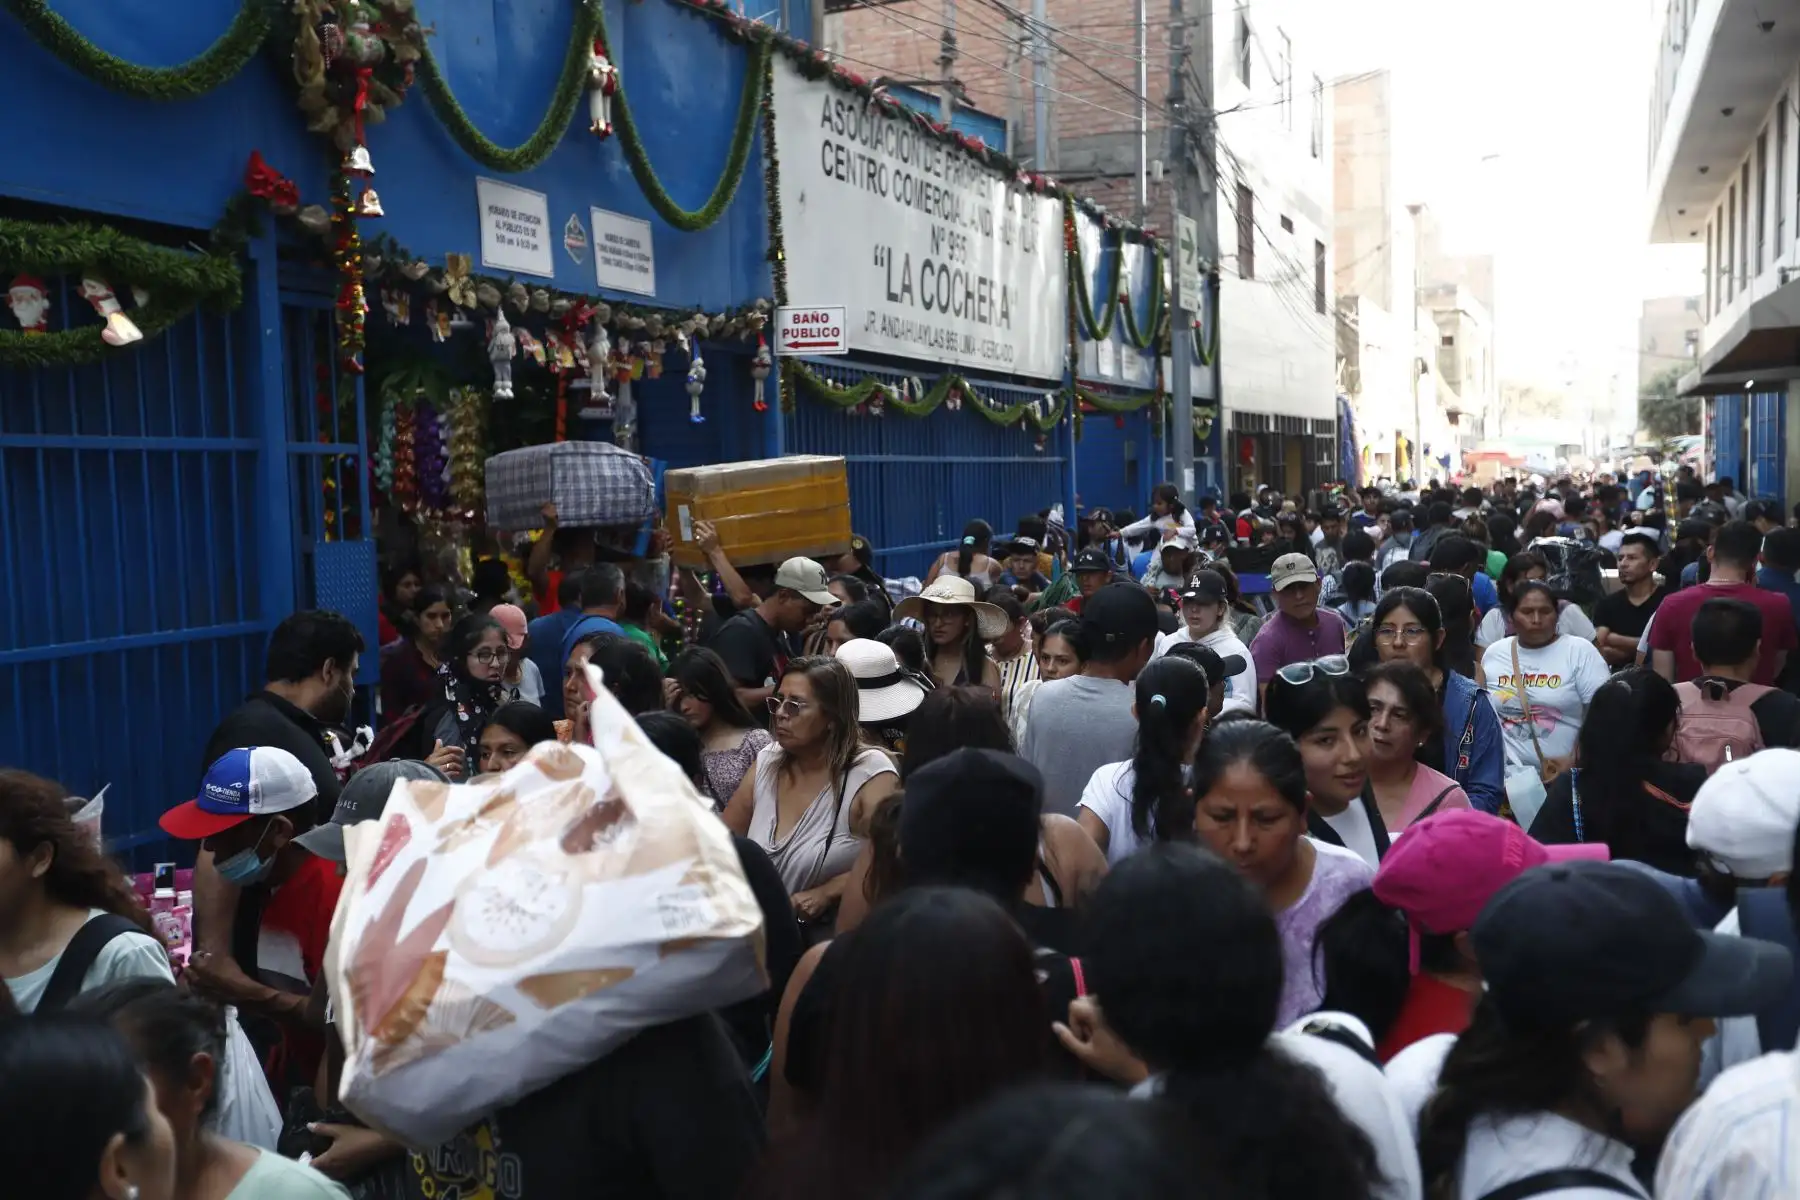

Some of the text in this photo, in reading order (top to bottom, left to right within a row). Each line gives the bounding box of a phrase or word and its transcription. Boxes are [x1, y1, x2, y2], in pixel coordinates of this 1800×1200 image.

[821, 139, 889, 198] CENTRO
[893, 169, 967, 228] COMERCIAL
[792, 311, 830, 325] BAÑO
[781, 326, 840, 339] PUBLICO
[1190, 574, 1201, 588] LA
